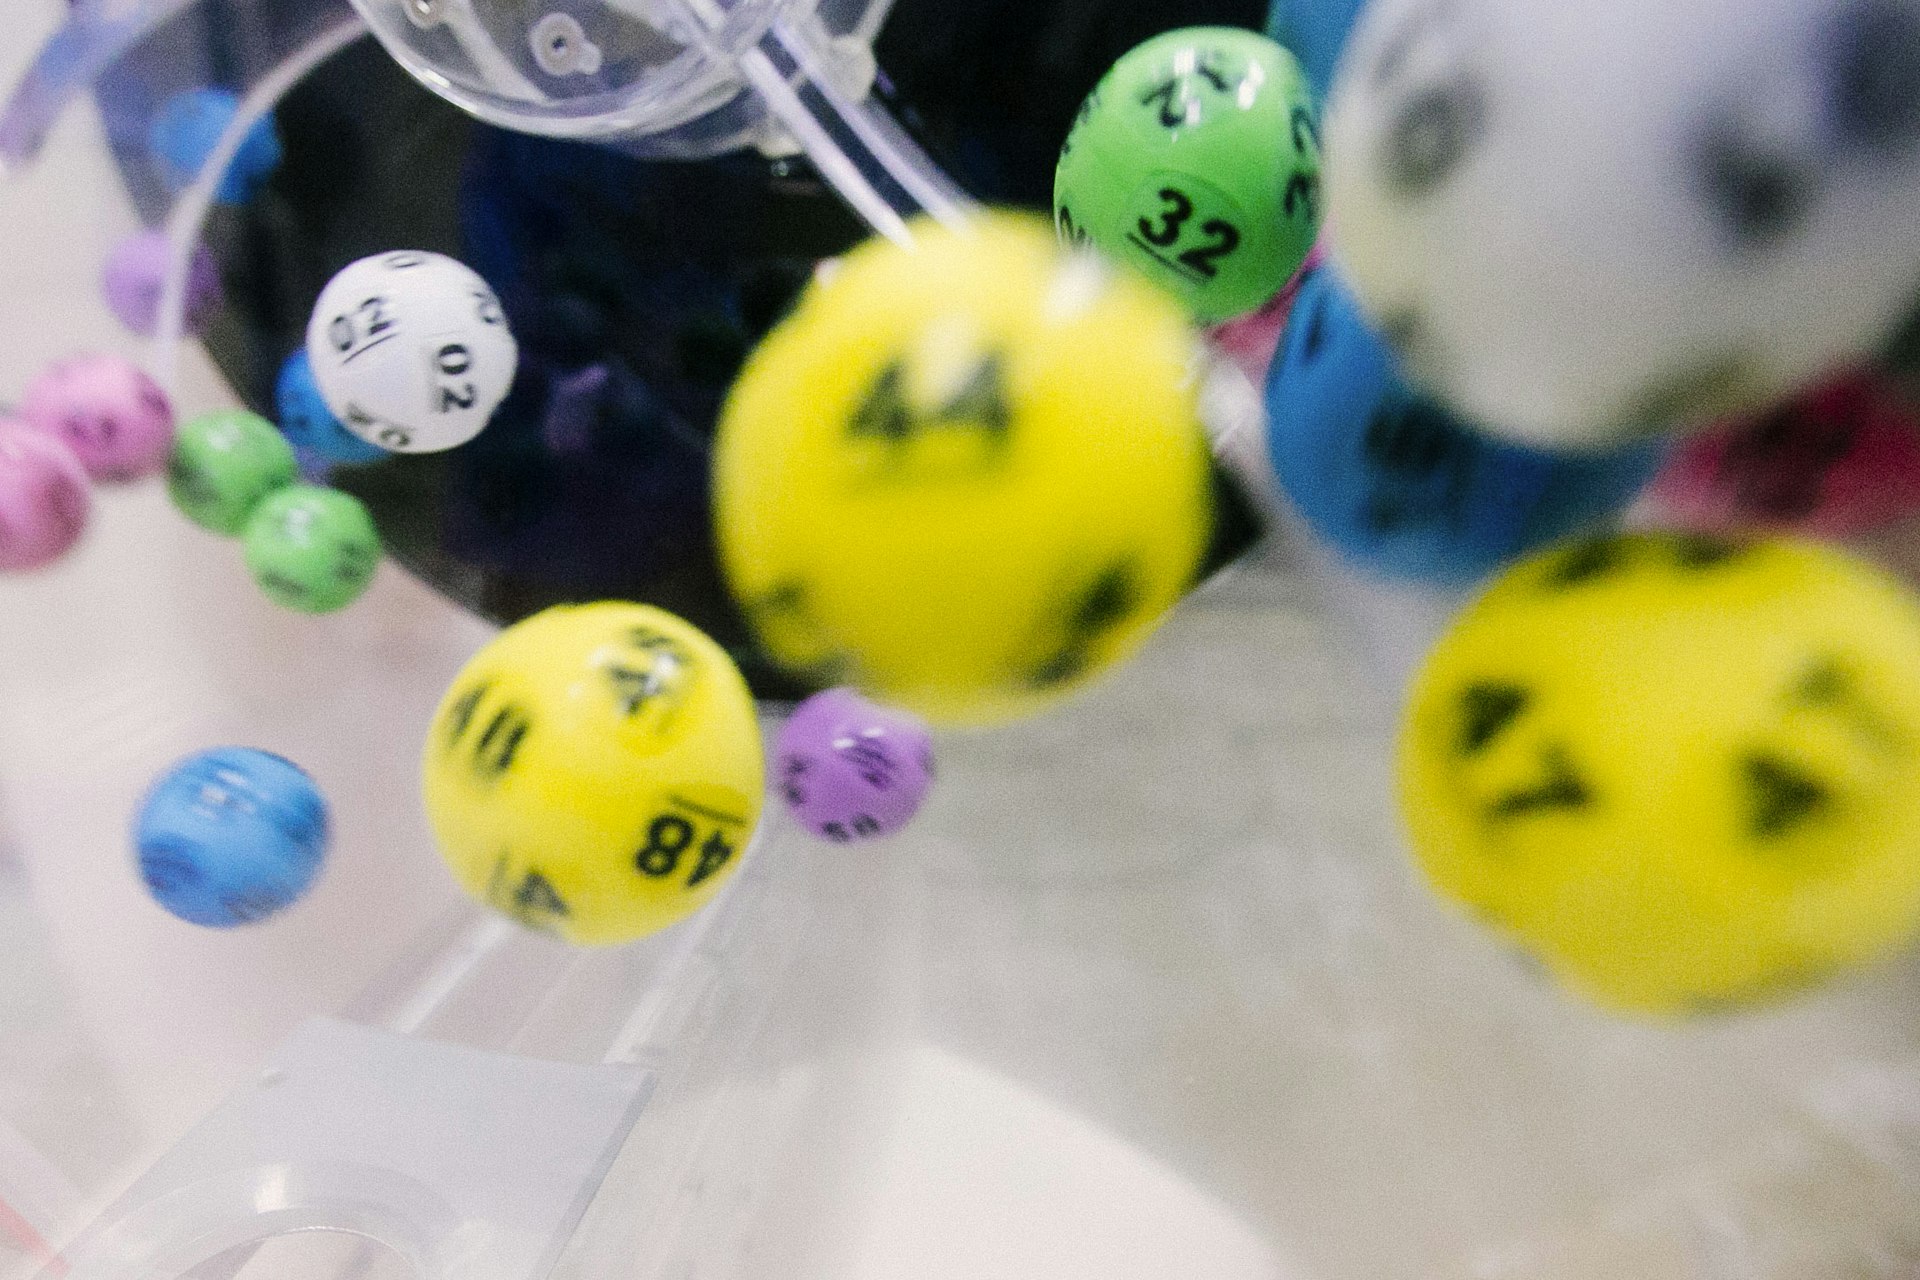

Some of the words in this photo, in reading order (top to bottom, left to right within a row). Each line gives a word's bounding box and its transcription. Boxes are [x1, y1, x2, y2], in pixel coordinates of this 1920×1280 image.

[1137, 186, 1242, 279] 32
[328, 296, 394, 353] 02
[431, 342, 477, 413] 02
[634, 812, 735, 889] 48
